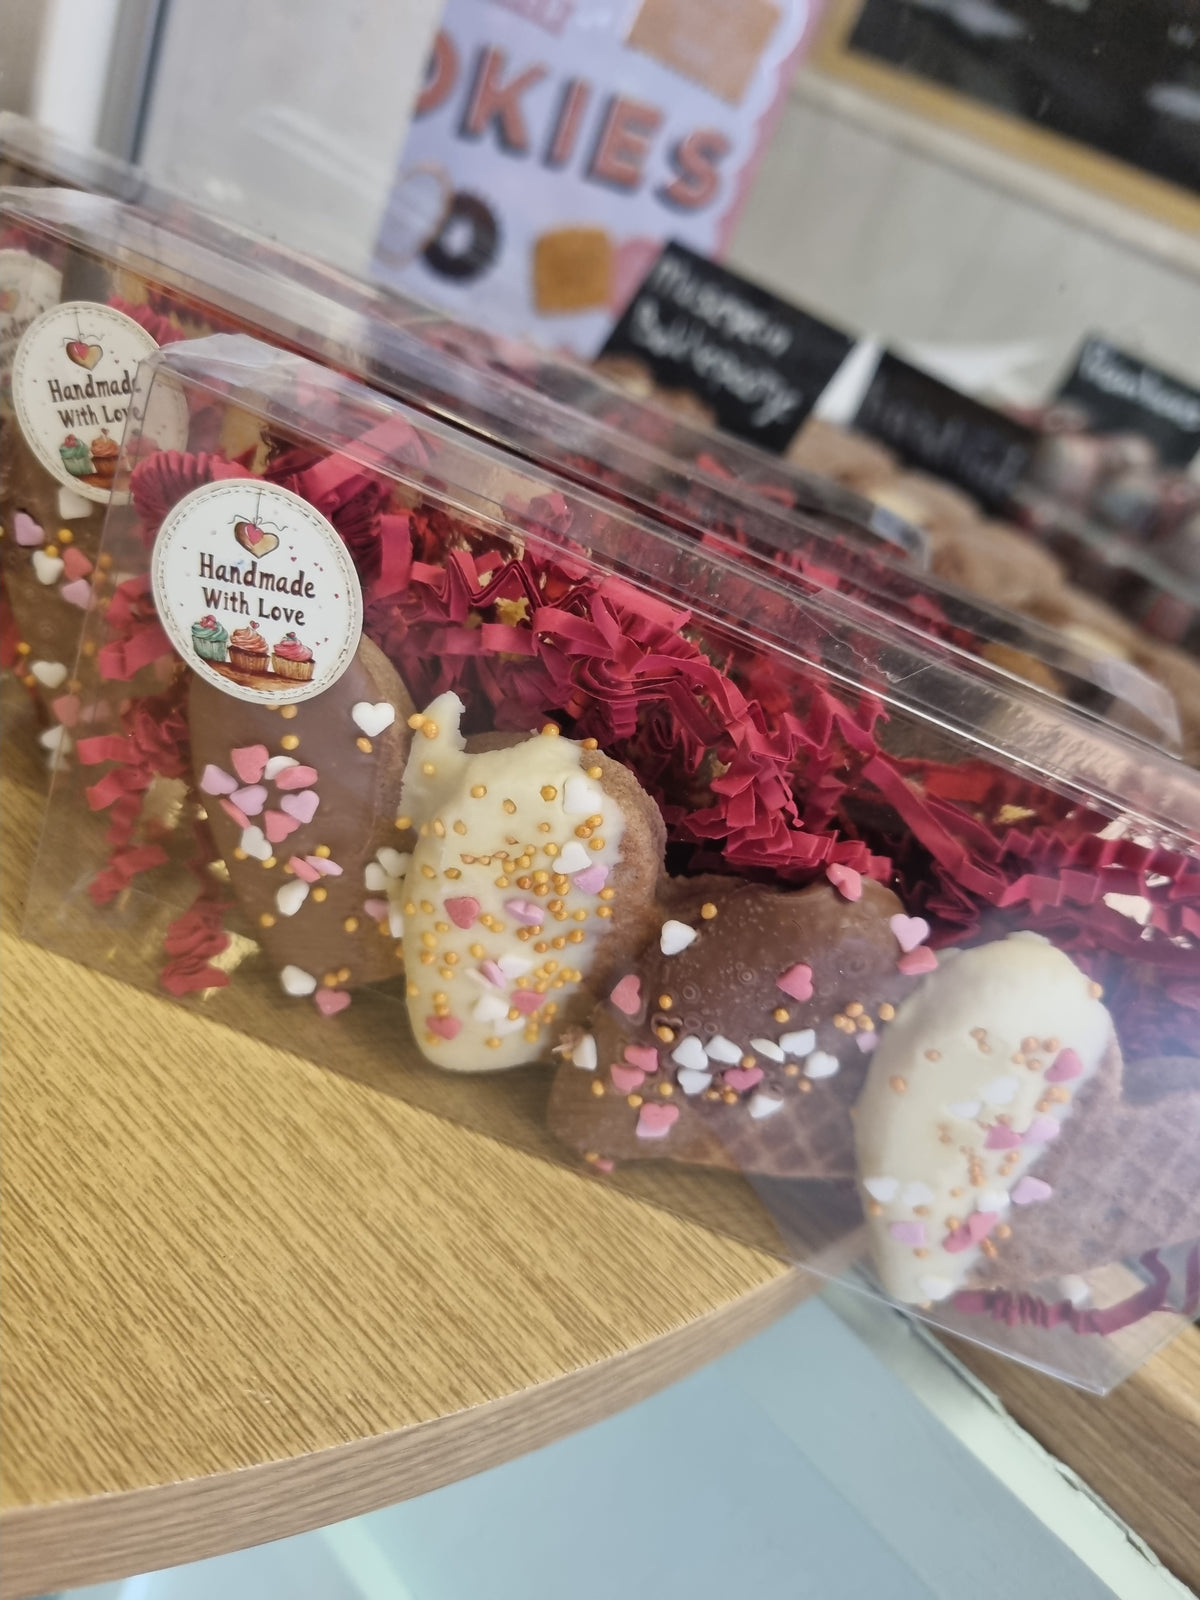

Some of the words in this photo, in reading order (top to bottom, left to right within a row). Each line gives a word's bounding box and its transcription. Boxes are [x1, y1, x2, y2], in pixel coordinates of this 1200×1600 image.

[57, 404, 100, 428] With
[199, 552, 316, 599] Handmade
[201, 586, 250, 615] With
[258, 598, 306, 626] Love
